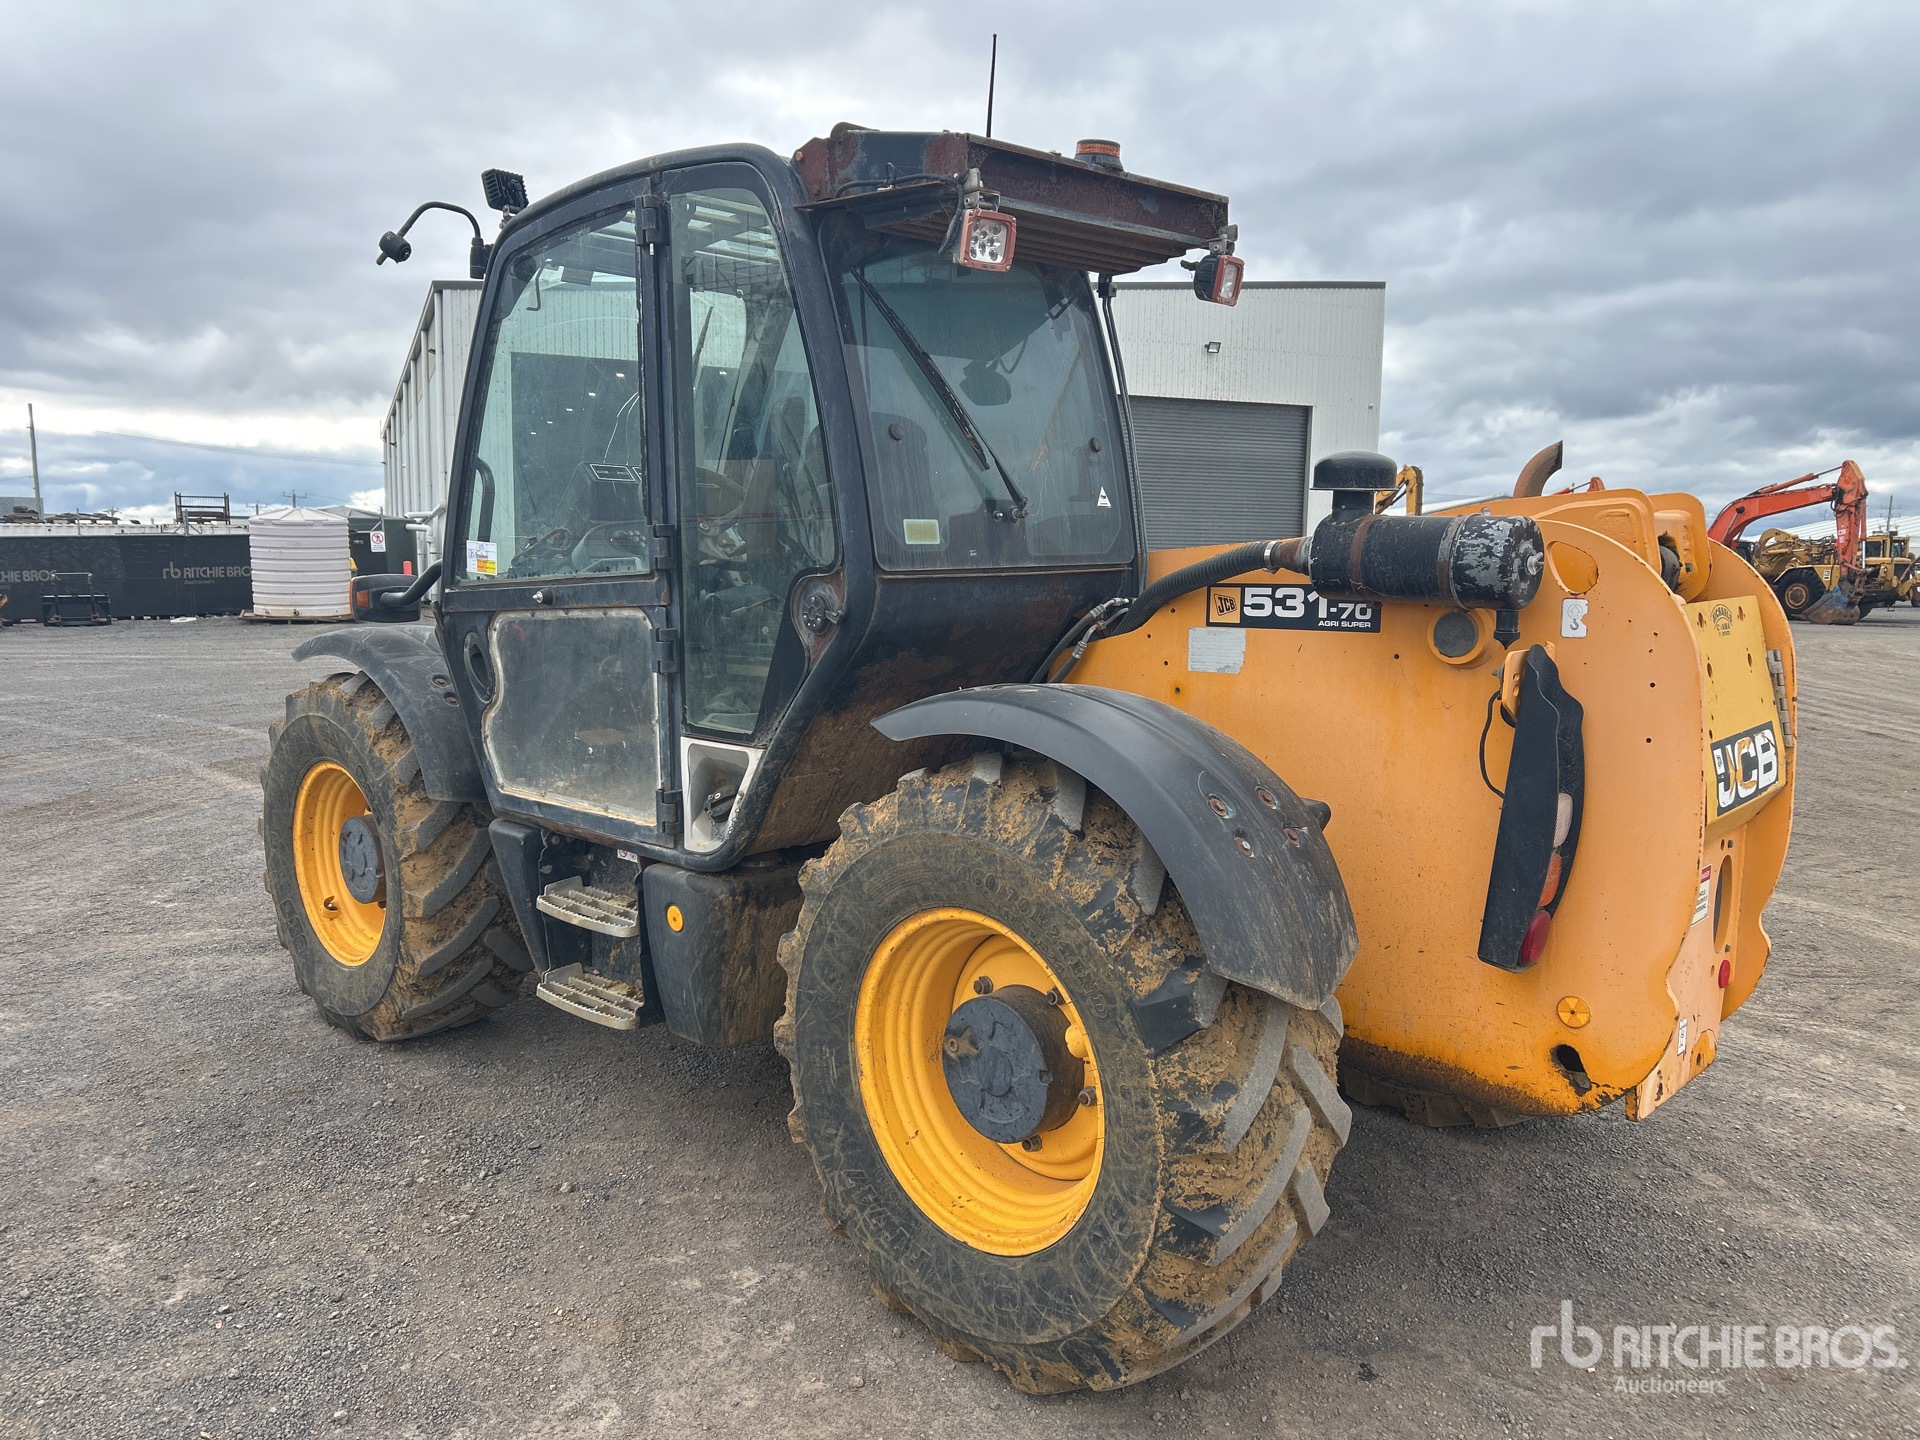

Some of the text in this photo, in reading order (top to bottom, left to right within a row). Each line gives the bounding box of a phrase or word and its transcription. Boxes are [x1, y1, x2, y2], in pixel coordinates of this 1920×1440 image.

[0, 570, 21, 582] HIE
[183, 566, 225, 579] RITCHIE
[1217, 596, 1236, 614] JCB
[1713, 729, 1777, 807] JCB
